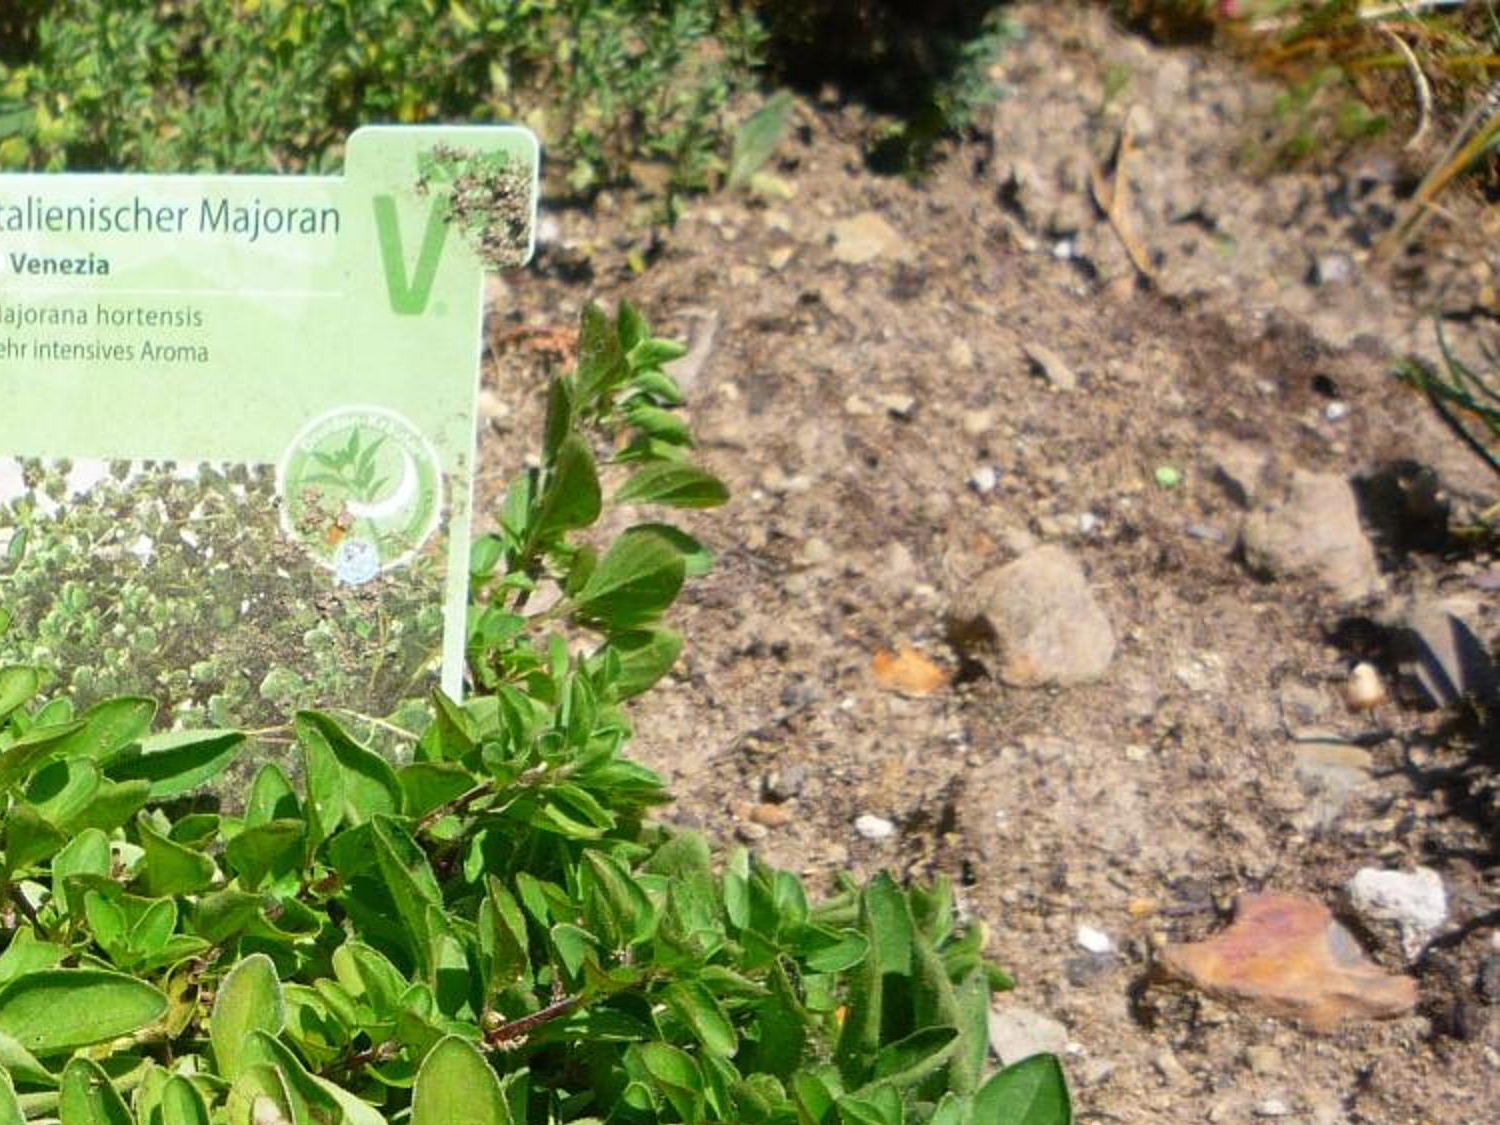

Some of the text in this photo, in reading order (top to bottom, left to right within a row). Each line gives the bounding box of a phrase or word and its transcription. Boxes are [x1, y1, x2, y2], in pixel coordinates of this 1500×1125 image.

[199, 198, 340, 242] Majoran
[10, 252, 110, 275] Venezia
[97, 303, 203, 327] hortensis
[33, 340, 134, 361] intensives
[140, 340, 209, 362] Aroma
